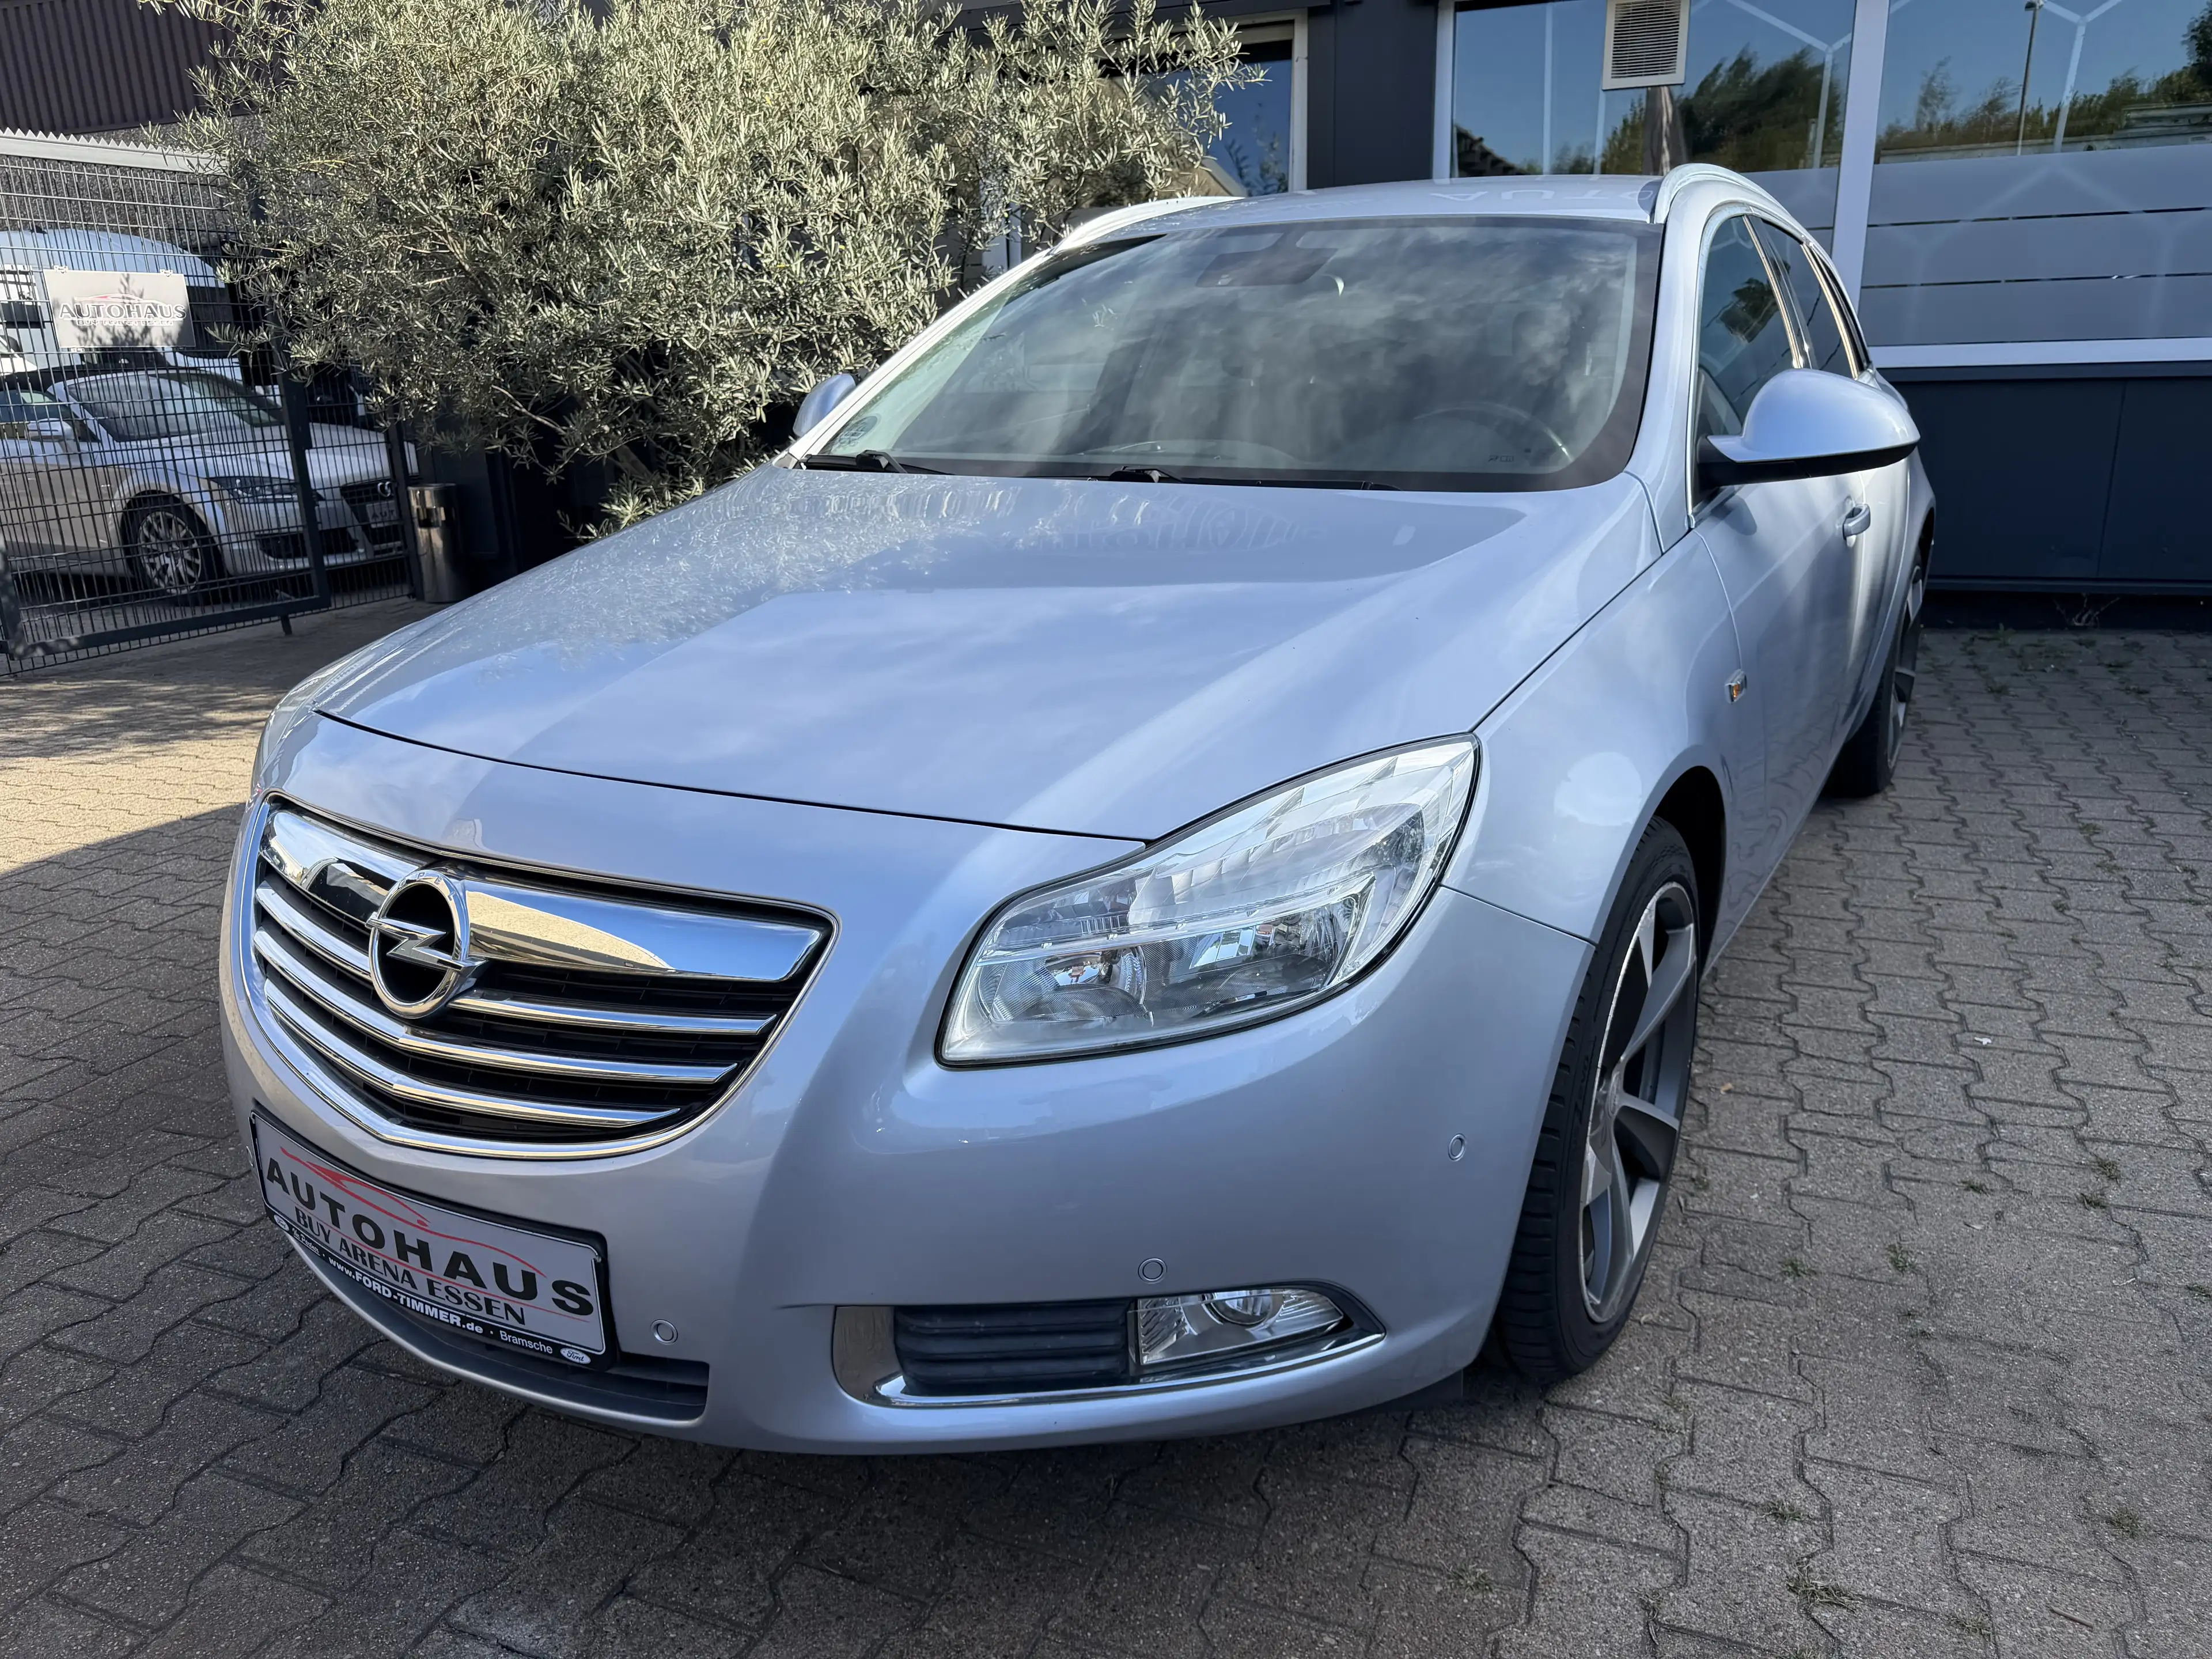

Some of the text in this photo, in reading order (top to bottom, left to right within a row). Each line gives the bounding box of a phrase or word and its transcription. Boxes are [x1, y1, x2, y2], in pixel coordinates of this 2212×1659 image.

[59, 304, 186, 319] AUTOHAUS
[398, 872, 456, 901] OPEL
[267, 1157, 594, 1316] AUTOHAUS
[295, 1206, 526, 1325] BUY ARENA ESSEN
[328, 1257, 553, 1354] www.FORD-TIMMER.de Bramsche
